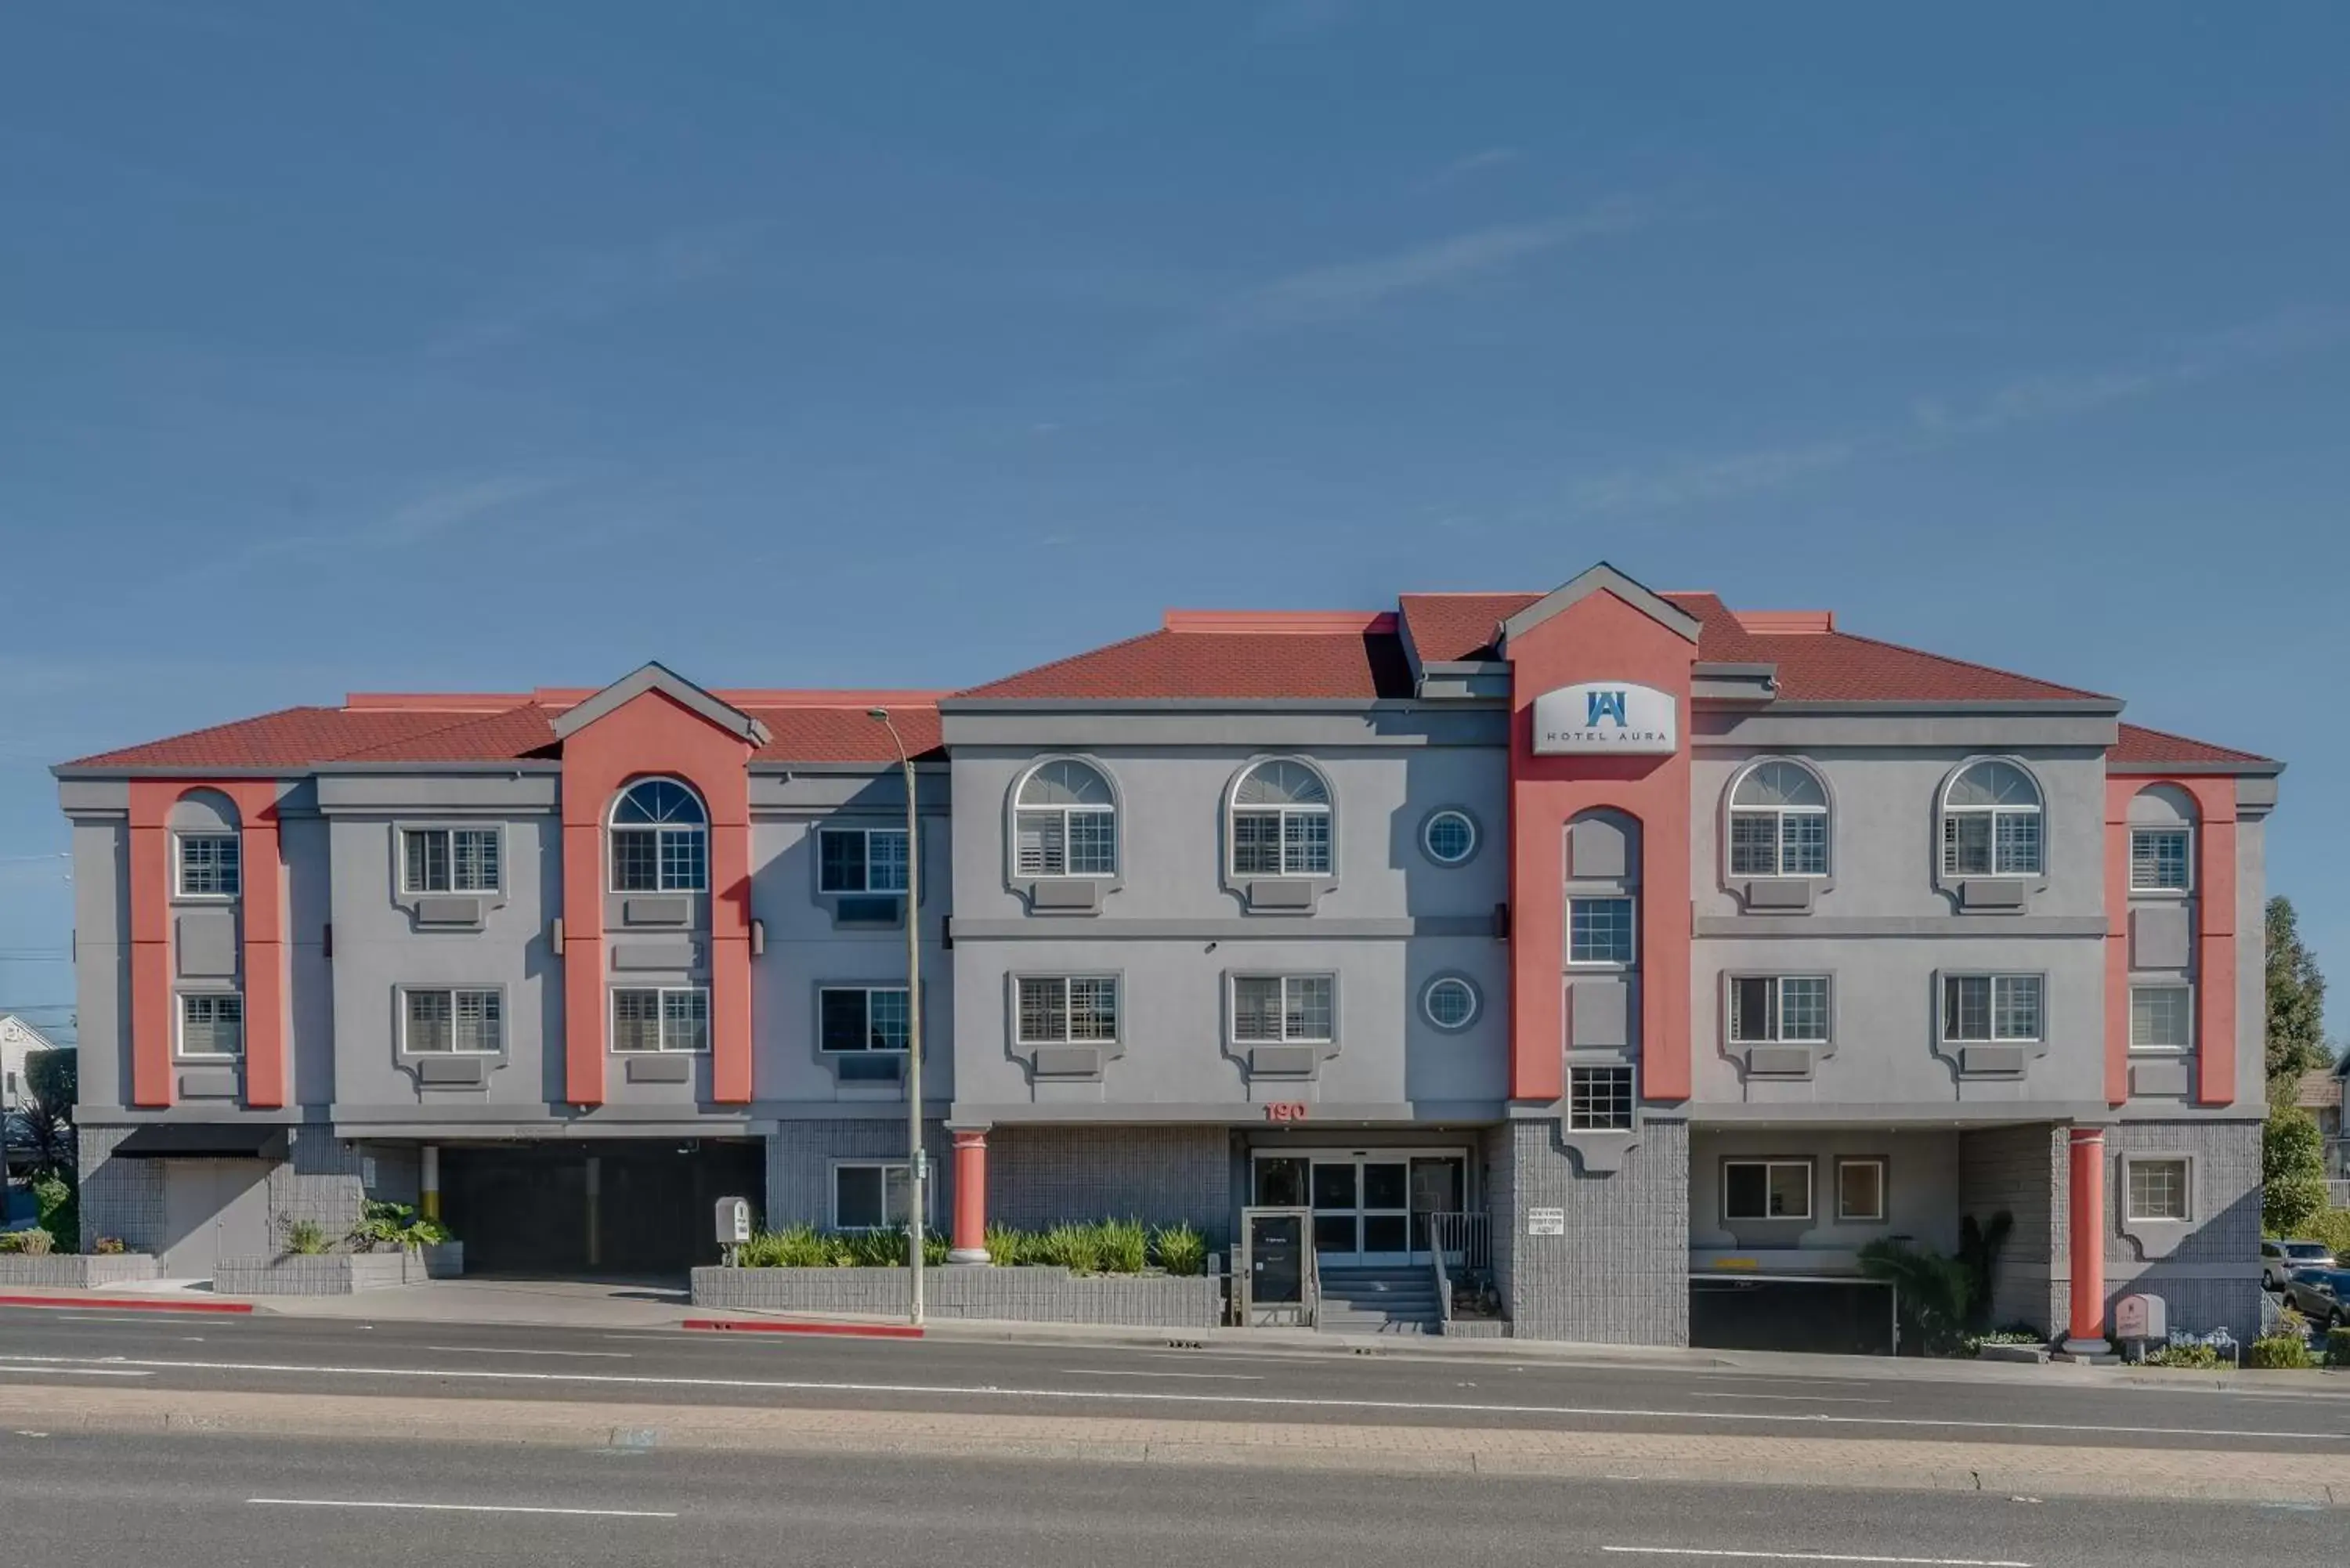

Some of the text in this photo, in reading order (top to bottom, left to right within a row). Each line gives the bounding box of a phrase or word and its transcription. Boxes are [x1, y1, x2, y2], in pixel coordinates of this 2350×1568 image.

[1547, 732, 1666, 741] HOTEL AURA
[1265, 1101, 1307, 1120] 190
